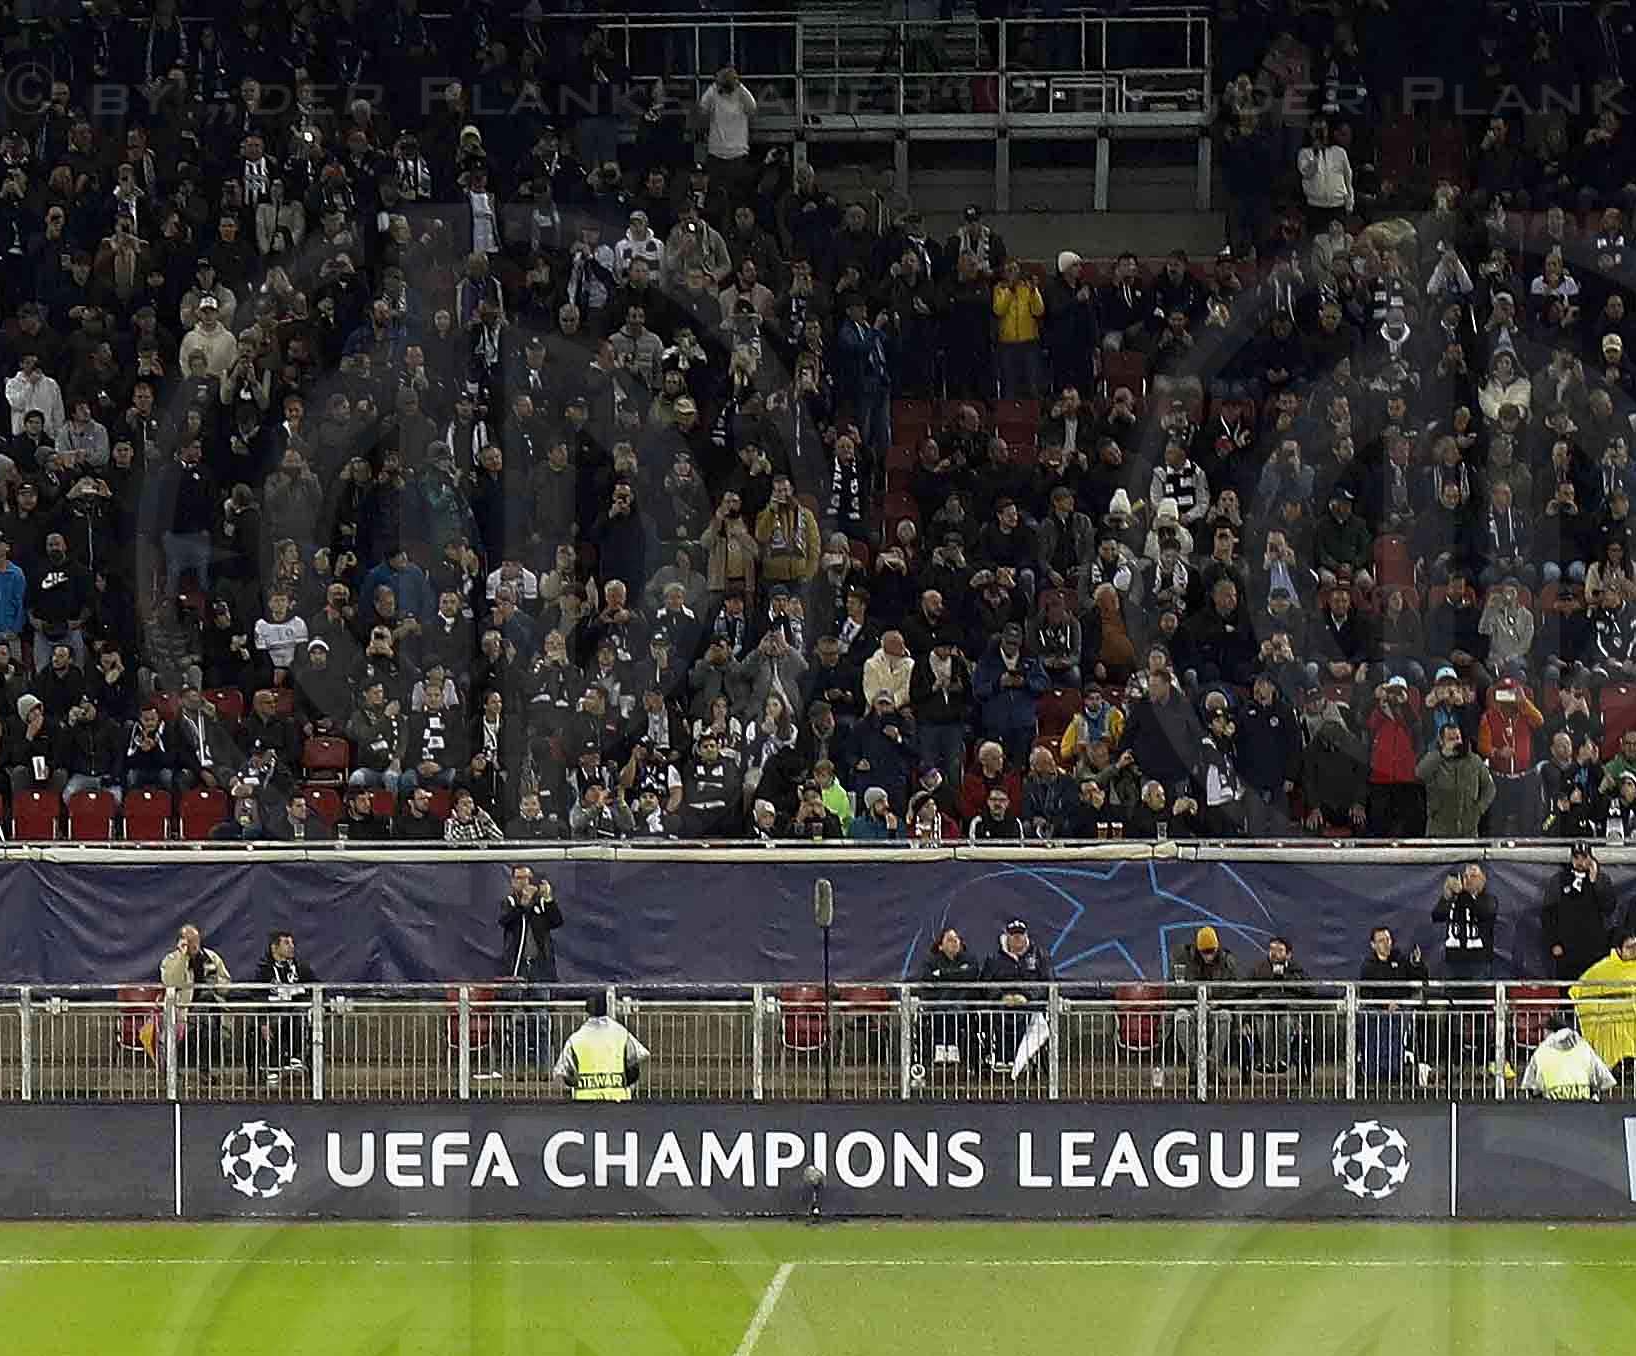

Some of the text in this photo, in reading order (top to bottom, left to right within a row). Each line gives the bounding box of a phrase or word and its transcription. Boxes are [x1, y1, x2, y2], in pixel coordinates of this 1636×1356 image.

[327, 1129, 1302, 1190] UEFA CHAMPIONS LEAGUE
